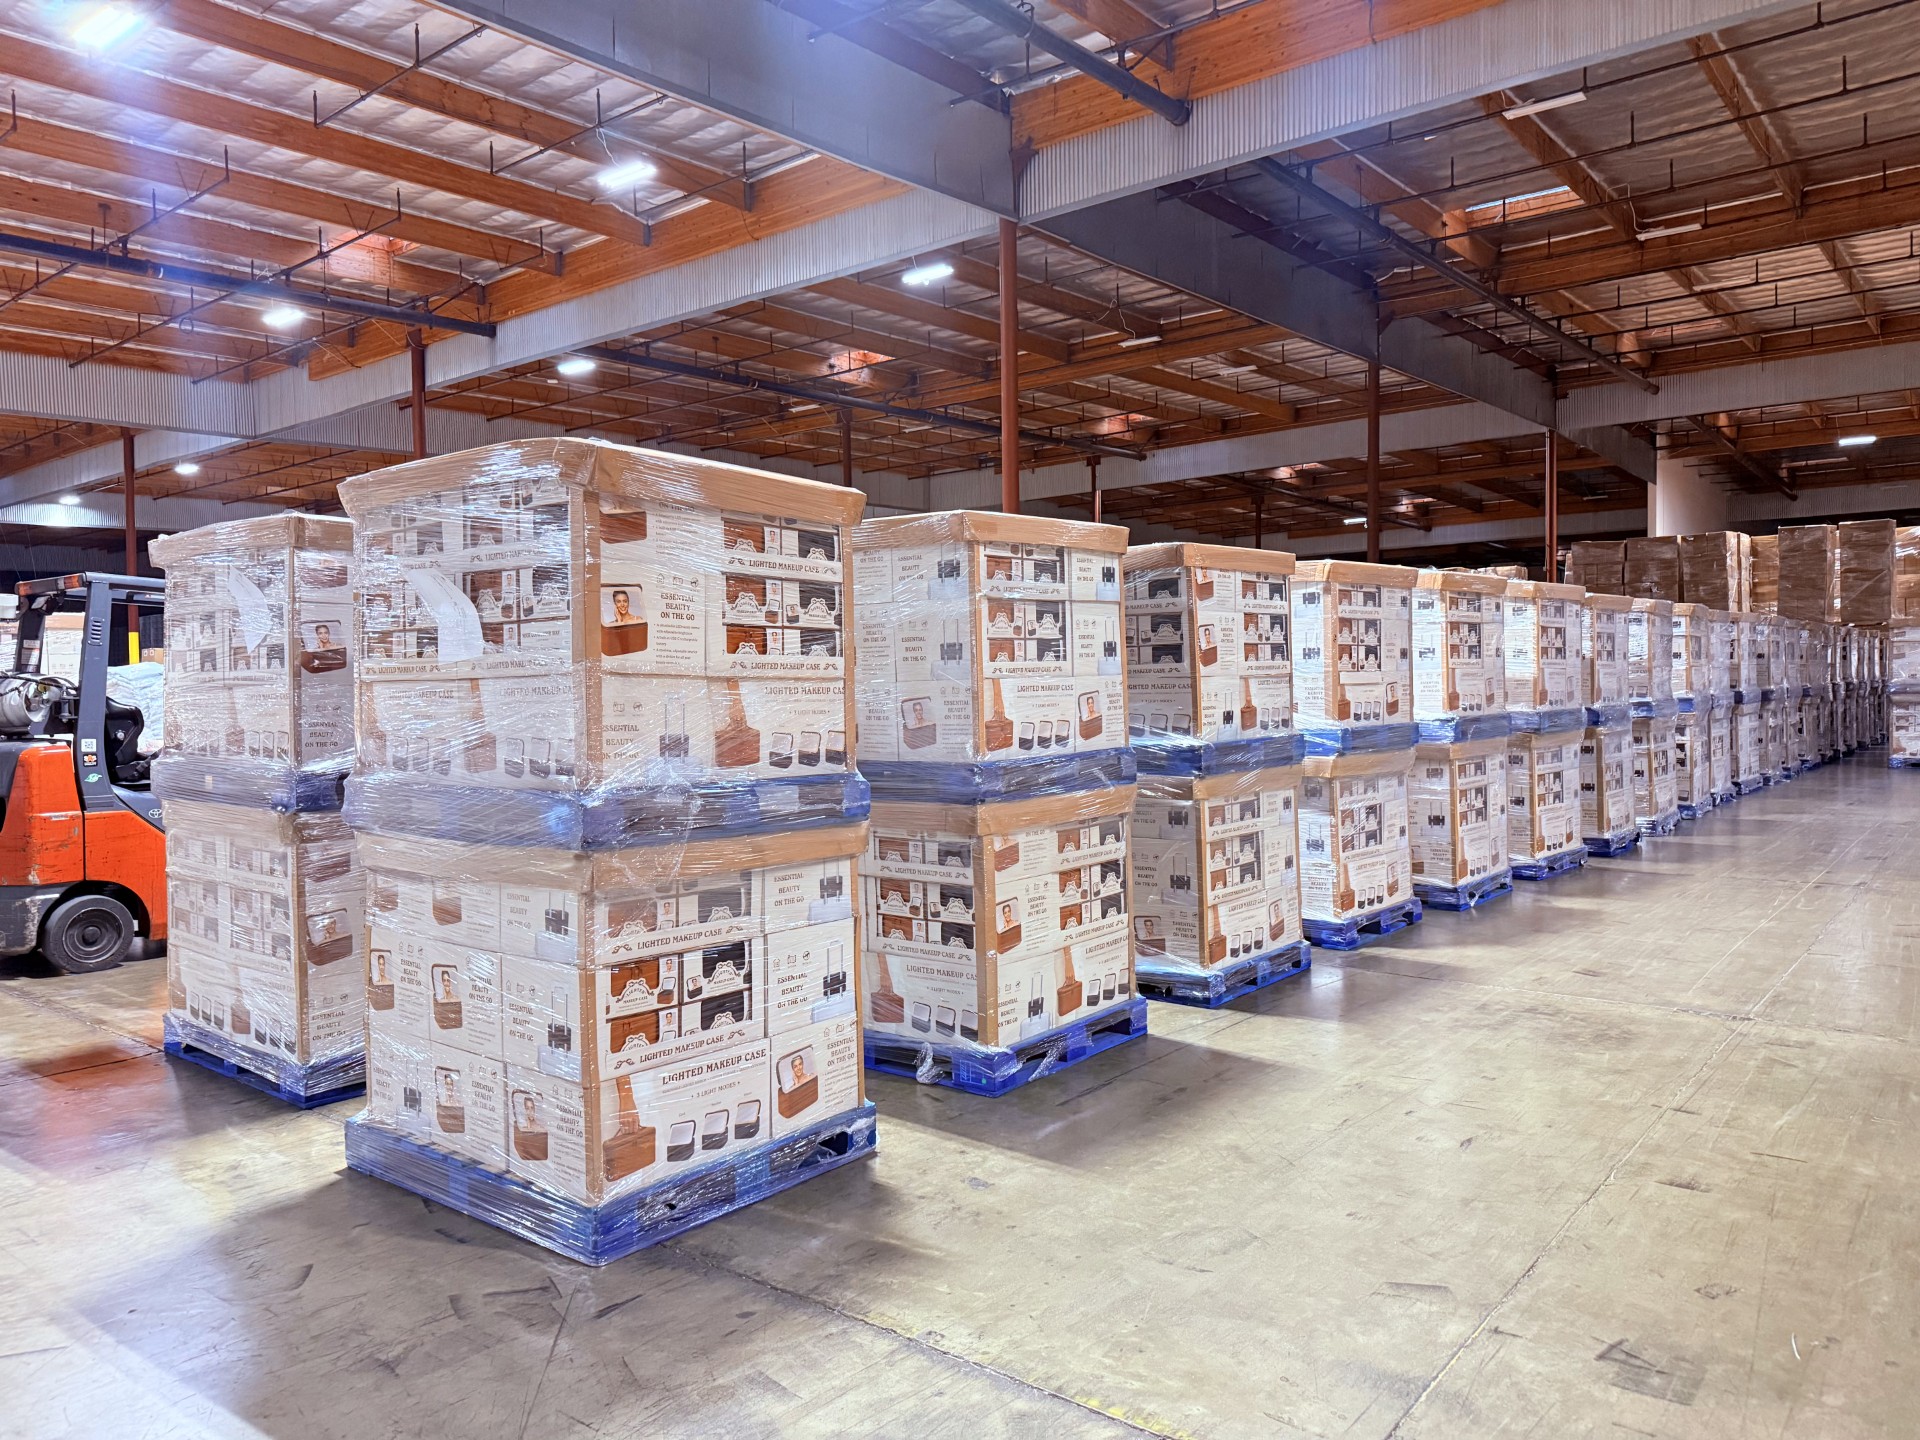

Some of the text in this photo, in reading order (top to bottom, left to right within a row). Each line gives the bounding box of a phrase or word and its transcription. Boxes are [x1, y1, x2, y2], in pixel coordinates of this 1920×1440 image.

[749, 560, 820, 573] LIGHTED MAKEUP CASE
[660, 592, 696, 603] ESSENTIAL
[665, 602, 691, 611] BEAUTY
[672, 612, 685, 620] THE
[686, 613, 695, 621] GO
[751, 661, 820, 671] LIGHTED MAKEUP CASE
[563, 686, 575, 695] CA
[765, 686, 845, 696] LIGHTED MAKEUP CAS
[1017, 684, 1039, 693] LIGHTED
[606, 738, 634, 746] BEAUTY
[894, 867, 916, 875] LIGHTED
[917, 869, 938, 877] MAKEUP
[774, 872, 804, 883] ESSENTIAL
[779, 885, 801, 894] BEAUTY
[637, 927, 722, 950] LIGHTED MAKEUP CASE
[897, 945, 956, 959] LIGHTED MAKEUP CASE
[906, 964, 964, 979] LIGHTED MAKEUP
[777, 972, 808, 985] ESSENTIAL
[778, 1000, 786, 1009] ON
[787, 998, 799, 1006] THE
[317, 1021, 341, 1030] BEAUTY
[827, 1036, 855, 1050] ESSENTIAL
[640, 1050, 673, 1063] LIGHTED
[706, 1034, 724, 1046] CASE
[662, 1065, 704, 1085] LIGHTED
[705, 1055, 742, 1074] MAKEUP
[744, 1048, 767, 1063] CASE
[701, 1087, 717, 1097] LIGHT
